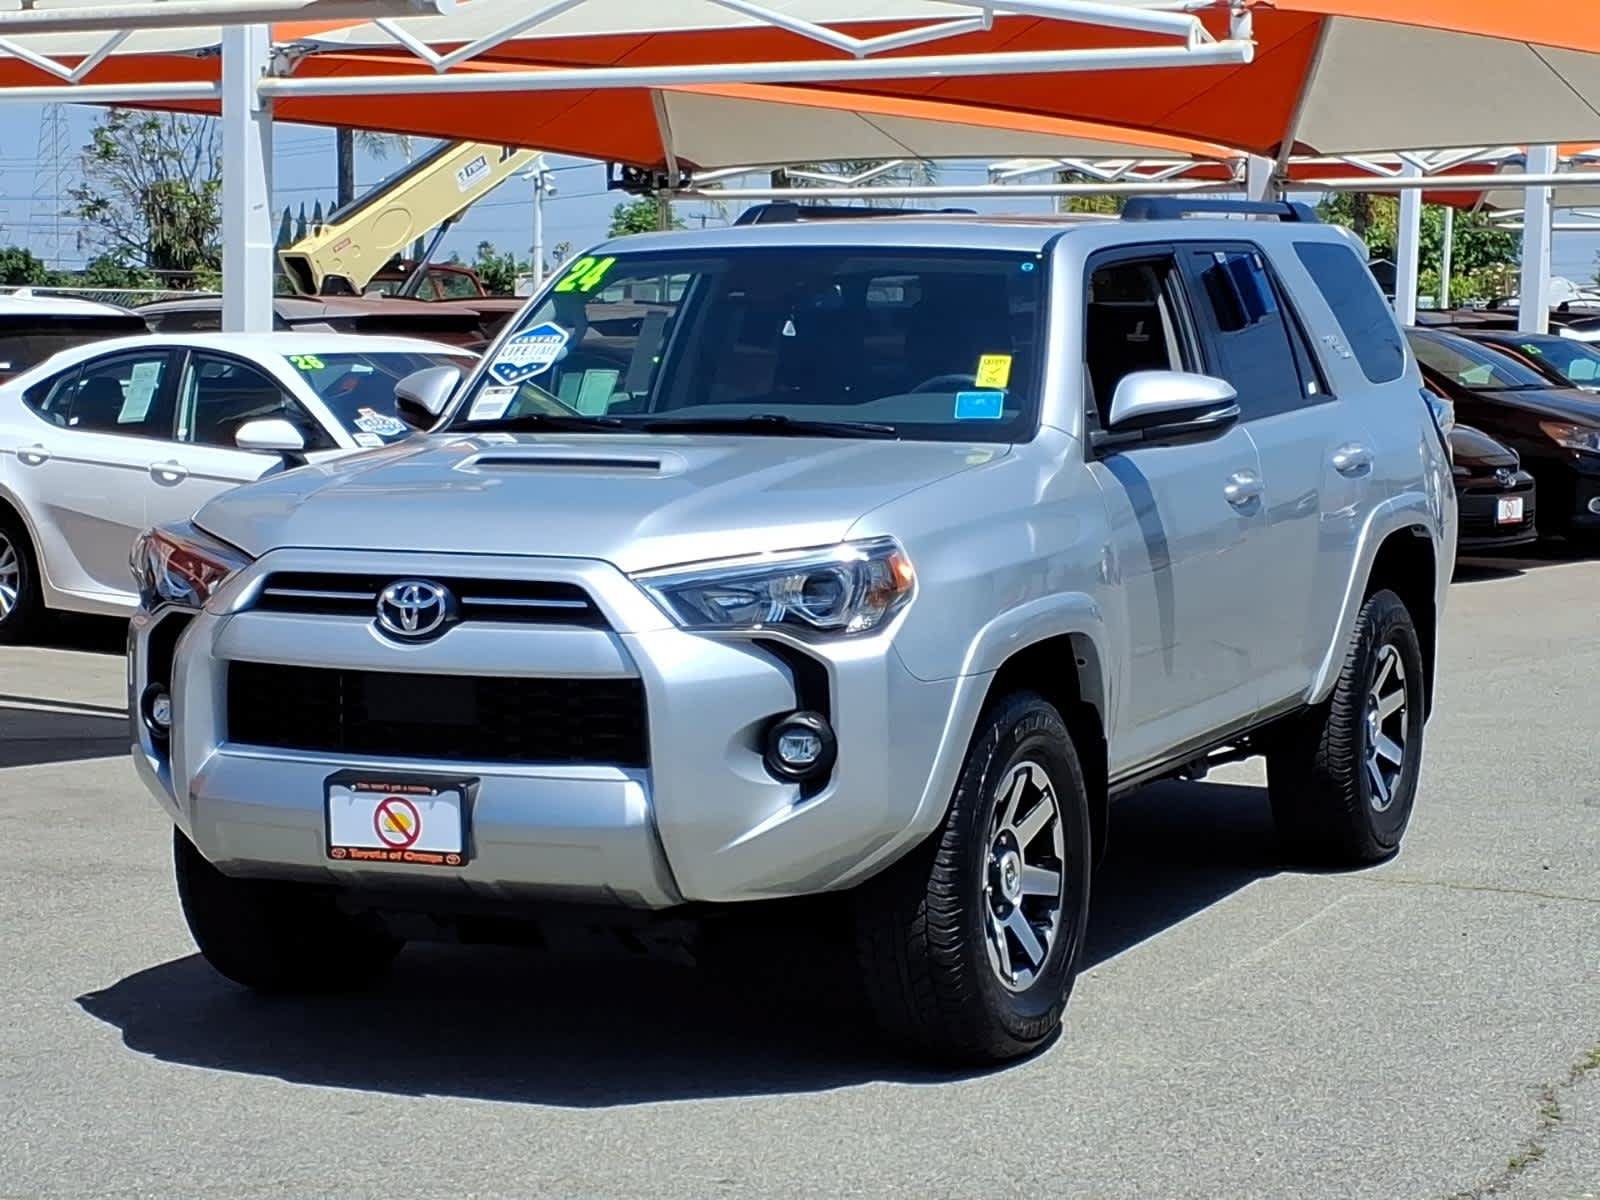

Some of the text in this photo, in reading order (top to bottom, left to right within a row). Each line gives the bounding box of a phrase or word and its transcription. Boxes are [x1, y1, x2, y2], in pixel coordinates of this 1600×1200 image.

[554, 256, 617, 292] 24
[349, 848, 387, 861] Toyota
[388, 850, 402, 860] of
